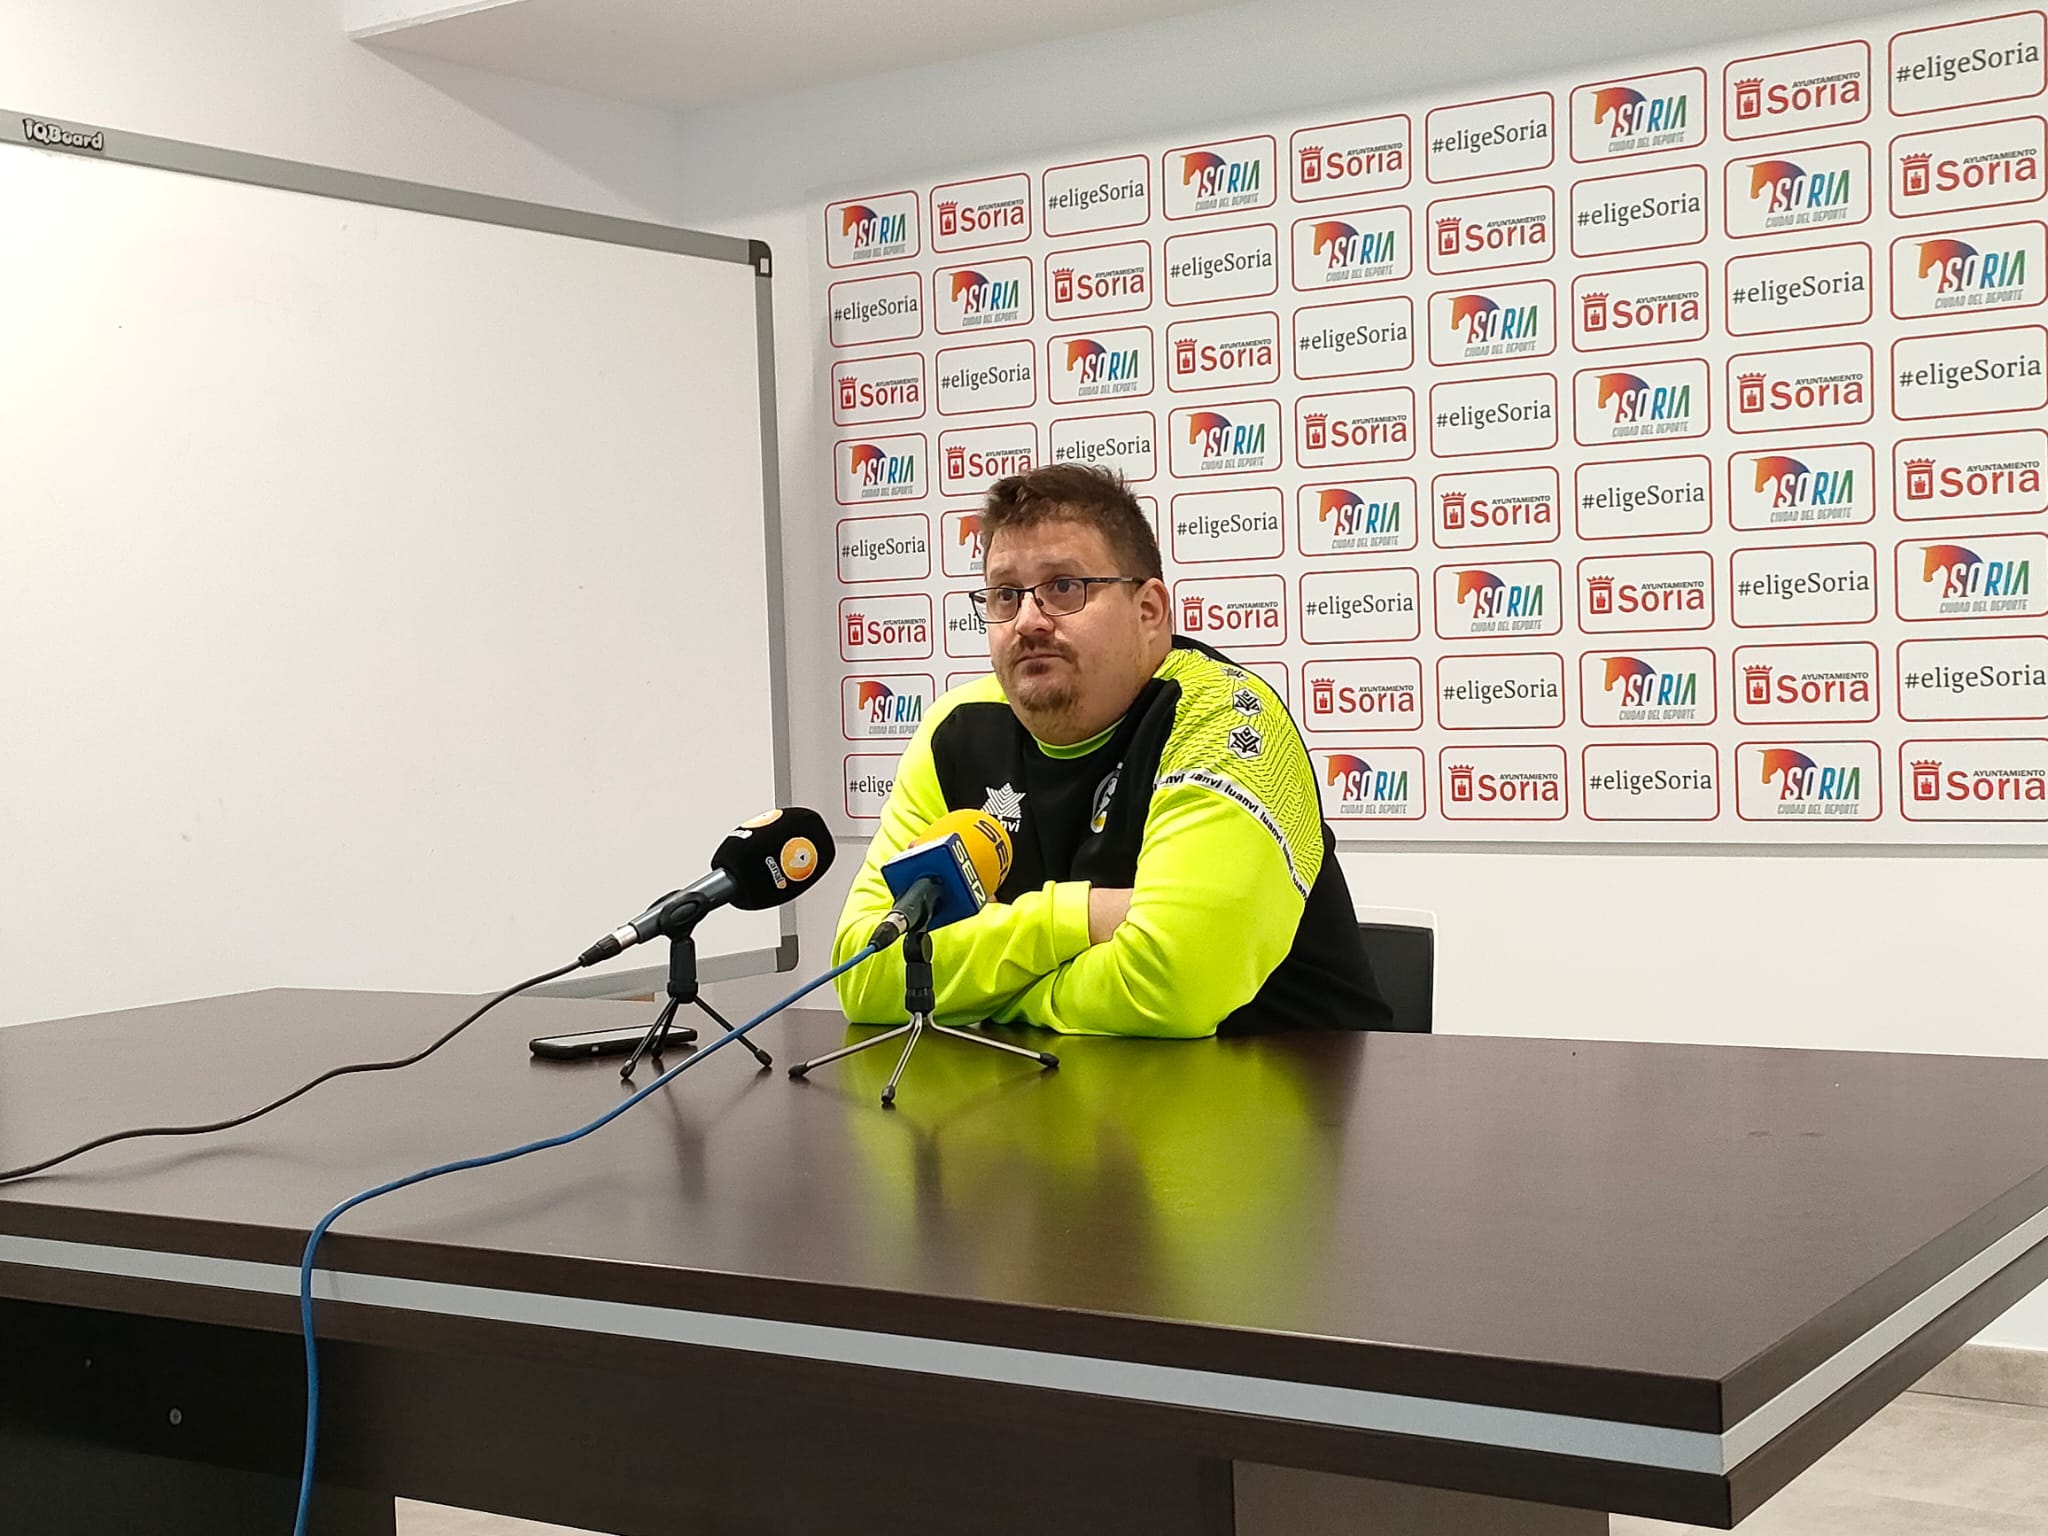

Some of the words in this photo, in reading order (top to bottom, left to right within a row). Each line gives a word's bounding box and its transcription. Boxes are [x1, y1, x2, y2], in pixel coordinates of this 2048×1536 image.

[1896, 42, 2039, 82] #eligeSoria
[1792, 72, 1860, 88] AYUNTAMIENTO
[1767, 81, 1859, 114] Soria
[1611, 95, 1686, 138] SORIA
[22, 118, 104, 151] IQBoard
[1431, 120, 1547, 153] #eligeSoria
[1636, 137, 1650, 148] DEL
[1652, 131, 1685, 146] DEPORTE
[1347, 142, 1403, 156] AYUNTAMIENTO
[1963, 149, 2037, 164] AYUNTAMIENTO
[1326, 151, 1402, 179] Soria
[1936, 157, 2036, 191] Soria
[1197, 160, 1259, 198] SORIA
[1769, 170, 1849, 213] SORIA
[1048, 180, 1144, 209] #eligeSoria
[1219, 197, 1229, 208] DEL
[1232, 193, 1259, 206] DEPORTE
[961, 206, 1023, 232] Soria
[1487, 215, 1546, 228] AYUNTAMIENTO
[1577, 193, 1700, 226] #eligeSoria
[1796, 213, 1810, 224] DEL
[1813, 208, 1848, 222] DEPORTE
[854, 214, 905, 248] SORIA
[1465, 223, 1545, 252] Soria
[1328, 231, 1394, 268] SORIA
[1095, 267, 1144, 278] AYUNTAMIENTO
[1170, 249, 1272, 278] #eligeSoria
[1351, 269, 1362, 279] DEL
[1365, 264, 1393, 277] DEPORTE
[1938, 250, 2025, 293] SORIA
[963, 280, 1018, 314] SORIA
[1078, 275, 1144, 300] Soria
[1636, 292, 1699, 304] AYUNTAMIENTO
[1732, 272, 1864, 305] #eligeSoria
[1968, 294, 1983, 305] DEL
[1986, 289, 2023, 304] DEPORTE
[833, 296, 917, 322] #eligeSoria
[1613, 300, 1698, 328] Soria
[1299, 323, 1407, 352] #eligeSoria
[1467, 306, 1537, 344] SORIA
[1220, 339, 1271, 349] AYUNTAMIENTO
[1491, 344, 1503, 355] DEL
[1506, 340, 1536, 353] DEPORTE
[1080, 350, 1137, 383] SORIA
[1201, 346, 1271, 371] Soria
[941, 364, 1030, 390] #eligeSoria
[1795, 374, 1863, 385] AYUNTAMIENTO
[1899, 355, 2041, 389] #eligeSoria
[860, 384, 918, 407] Soria
[1100, 385, 1110, 394] DEL
[1112, 381, 1137, 393] DEPORTE
[1771, 381, 1862, 410] Soria
[1436, 400, 1551, 429] #eligeSoria
[1615, 385, 1689, 423] SORIA
[1352, 415, 1406, 424] AYUNTAMIENTO
[1640, 424, 1653, 435] DEL
[1656, 421, 1688, 434] DEPORTE
[1203, 424, 1264, 457] SORIA
[1331, 421, 1406, 447] Soria
[1055, 435, 1151, 462] #eligeSoria
[862, 456, 913, 486] SORIA
[968, 452, 1032, 476] Soria
[1225, 459, 1235, 469] DEL
[1237, 456, 1264, 468] DEPORTE
[1967, 461, 2040, 472] AYUNTAMIENTO
[1773, 470, 1853, 508] SORIA
[1940, 468, 2039, 497] Soria
[1492, 495, 1550, 504] AYUNTAMIENTO
[1581, 483, 1704, 512] #eligeSoria
[1177, 512, 1278, 538] #eligeSoria
[1334, 502, 1399, 535] SORIA
[1470, 501, 1550, 527] Soria
[1800, 510, 1814, 521] DEL
[1817, 507, 1852, 520] DEPORTE
[841, 536, 925, 560] #eligeSoria
[1357, 538, 1368, 548] DEL
[1370, 536, 1399, 547] DEPORTE
[1641, 581, 1704, 589] AYUNTAMIENTO
[1738, 571, 1869, 599] #eligeSoria
[1943, 561, 2029, 598] SORIA
[1305, 593, 1413, 619] #eligeSoria
[1473, 585, 1542, 618] SORIA
[1618, 585, 1704, 612] Soria
[1972, 601, 1987, 612] DEL
[1990, 599, 2028, 611] DEPORTE
[1208, 605, 1278, 630] Soria
[1497, 621, 1509, 631] DEL
[1512, 620, 1542, 631] DEPORTE
[868, 621, 926, 644] Soria
[1777, 675, 1868, 703] Soria
[1802, 672, 1869, 680] AYUNTAMIENTO
[1904, 665, 2046, 693] #eligeSoria
[1339, 687, 1413, 713] Soria
[1443, 679, 1557, 704] #eligeSoria
[1621, 673, 1696, 706] SORIA
[870, 695, 921, 723] SORIA
[1648, 710, 1660, 720] DEL
[1663, 709, 1695, 719] DEPORTE
[849, 776, 893, 797] #elige
[1342, 770, 1407, 801] SORIA
[1478, 775, 1558, 801] Soria
[1589, 770, 1712, 795] #eligeSoria
[1780, 766, 1859, 800] SORIA
[1946, 771, 2045, 800] Soria
[1224, 784, 1259, 813] luanvi
[1365, 804, 1376, 814] DEL
[1379, 804, 1407, 814] DEPORTE
[1808, 804, 1821, 814] DEL
[1824, 804, 1859, 815] DEPORTE
